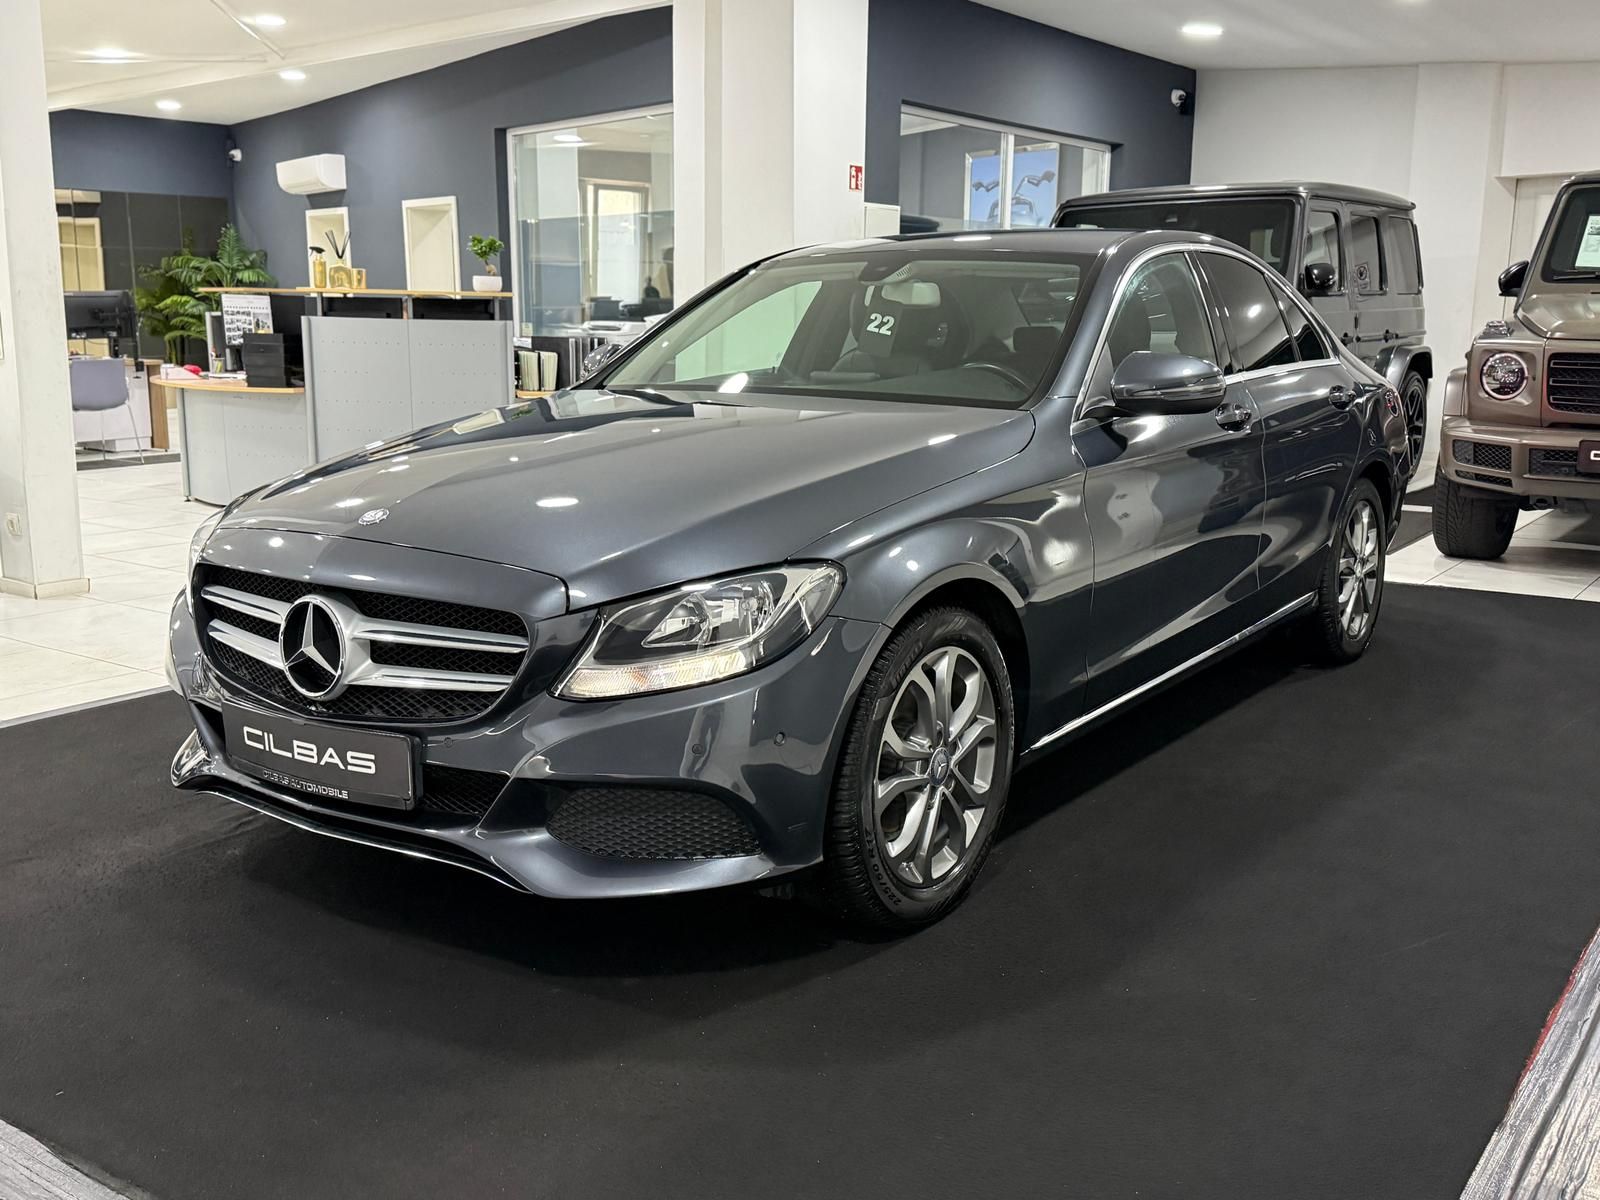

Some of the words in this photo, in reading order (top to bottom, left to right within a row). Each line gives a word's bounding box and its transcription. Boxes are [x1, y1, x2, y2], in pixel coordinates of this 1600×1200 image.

[866, 312, 895, 336] 22
[242, 725, 376, 775] CILBAS
[291, 778, 349, 800] AUTOMOBILE
[872, 863, 902, 906] 225/50
